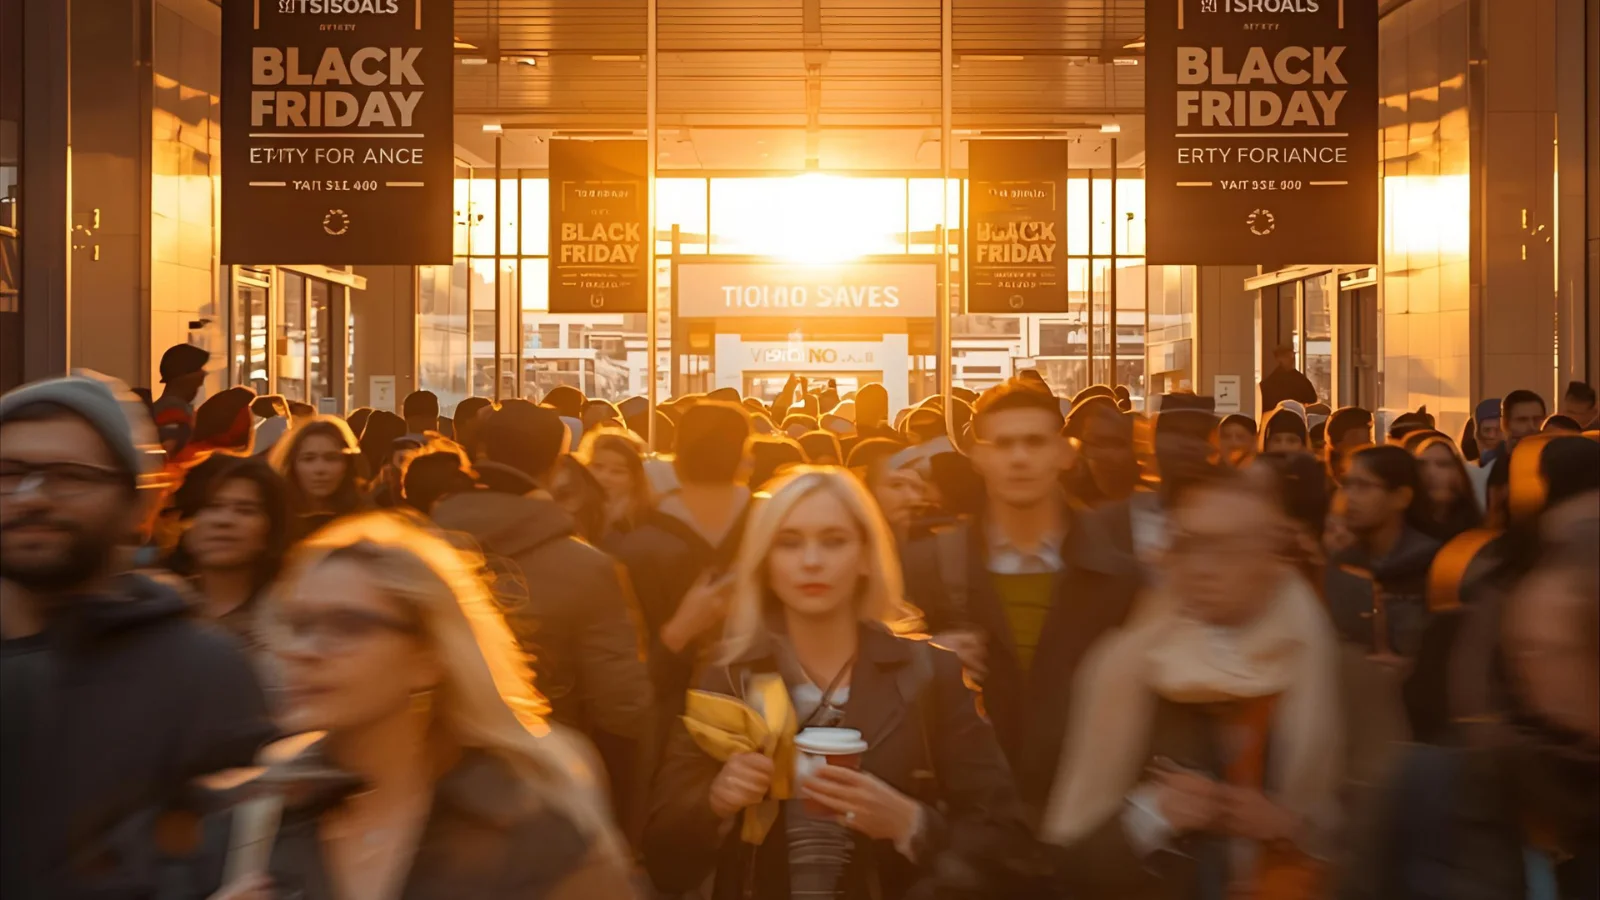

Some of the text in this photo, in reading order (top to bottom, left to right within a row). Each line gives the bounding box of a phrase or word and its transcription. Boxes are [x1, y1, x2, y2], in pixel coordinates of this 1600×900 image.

[252, 46, 425, 86] BLACK
[1177, 46, 1348, 85] BLACK
[251, 91, 424, 127] FRIDAY
[1177, 90, 1347, 126] FRIDAY
[315, 148, 355, 164] FOR
[363, 148, 424, 164] ANCE
[1178, 148, 1231, 163] ERTY
[561, 222, 640, 242] BLACK
[560, 244, 640, 263] FRIDAY
[976, 243, 1056, 263] FRIDAY
[815, 285, 900, 308] SAVES
